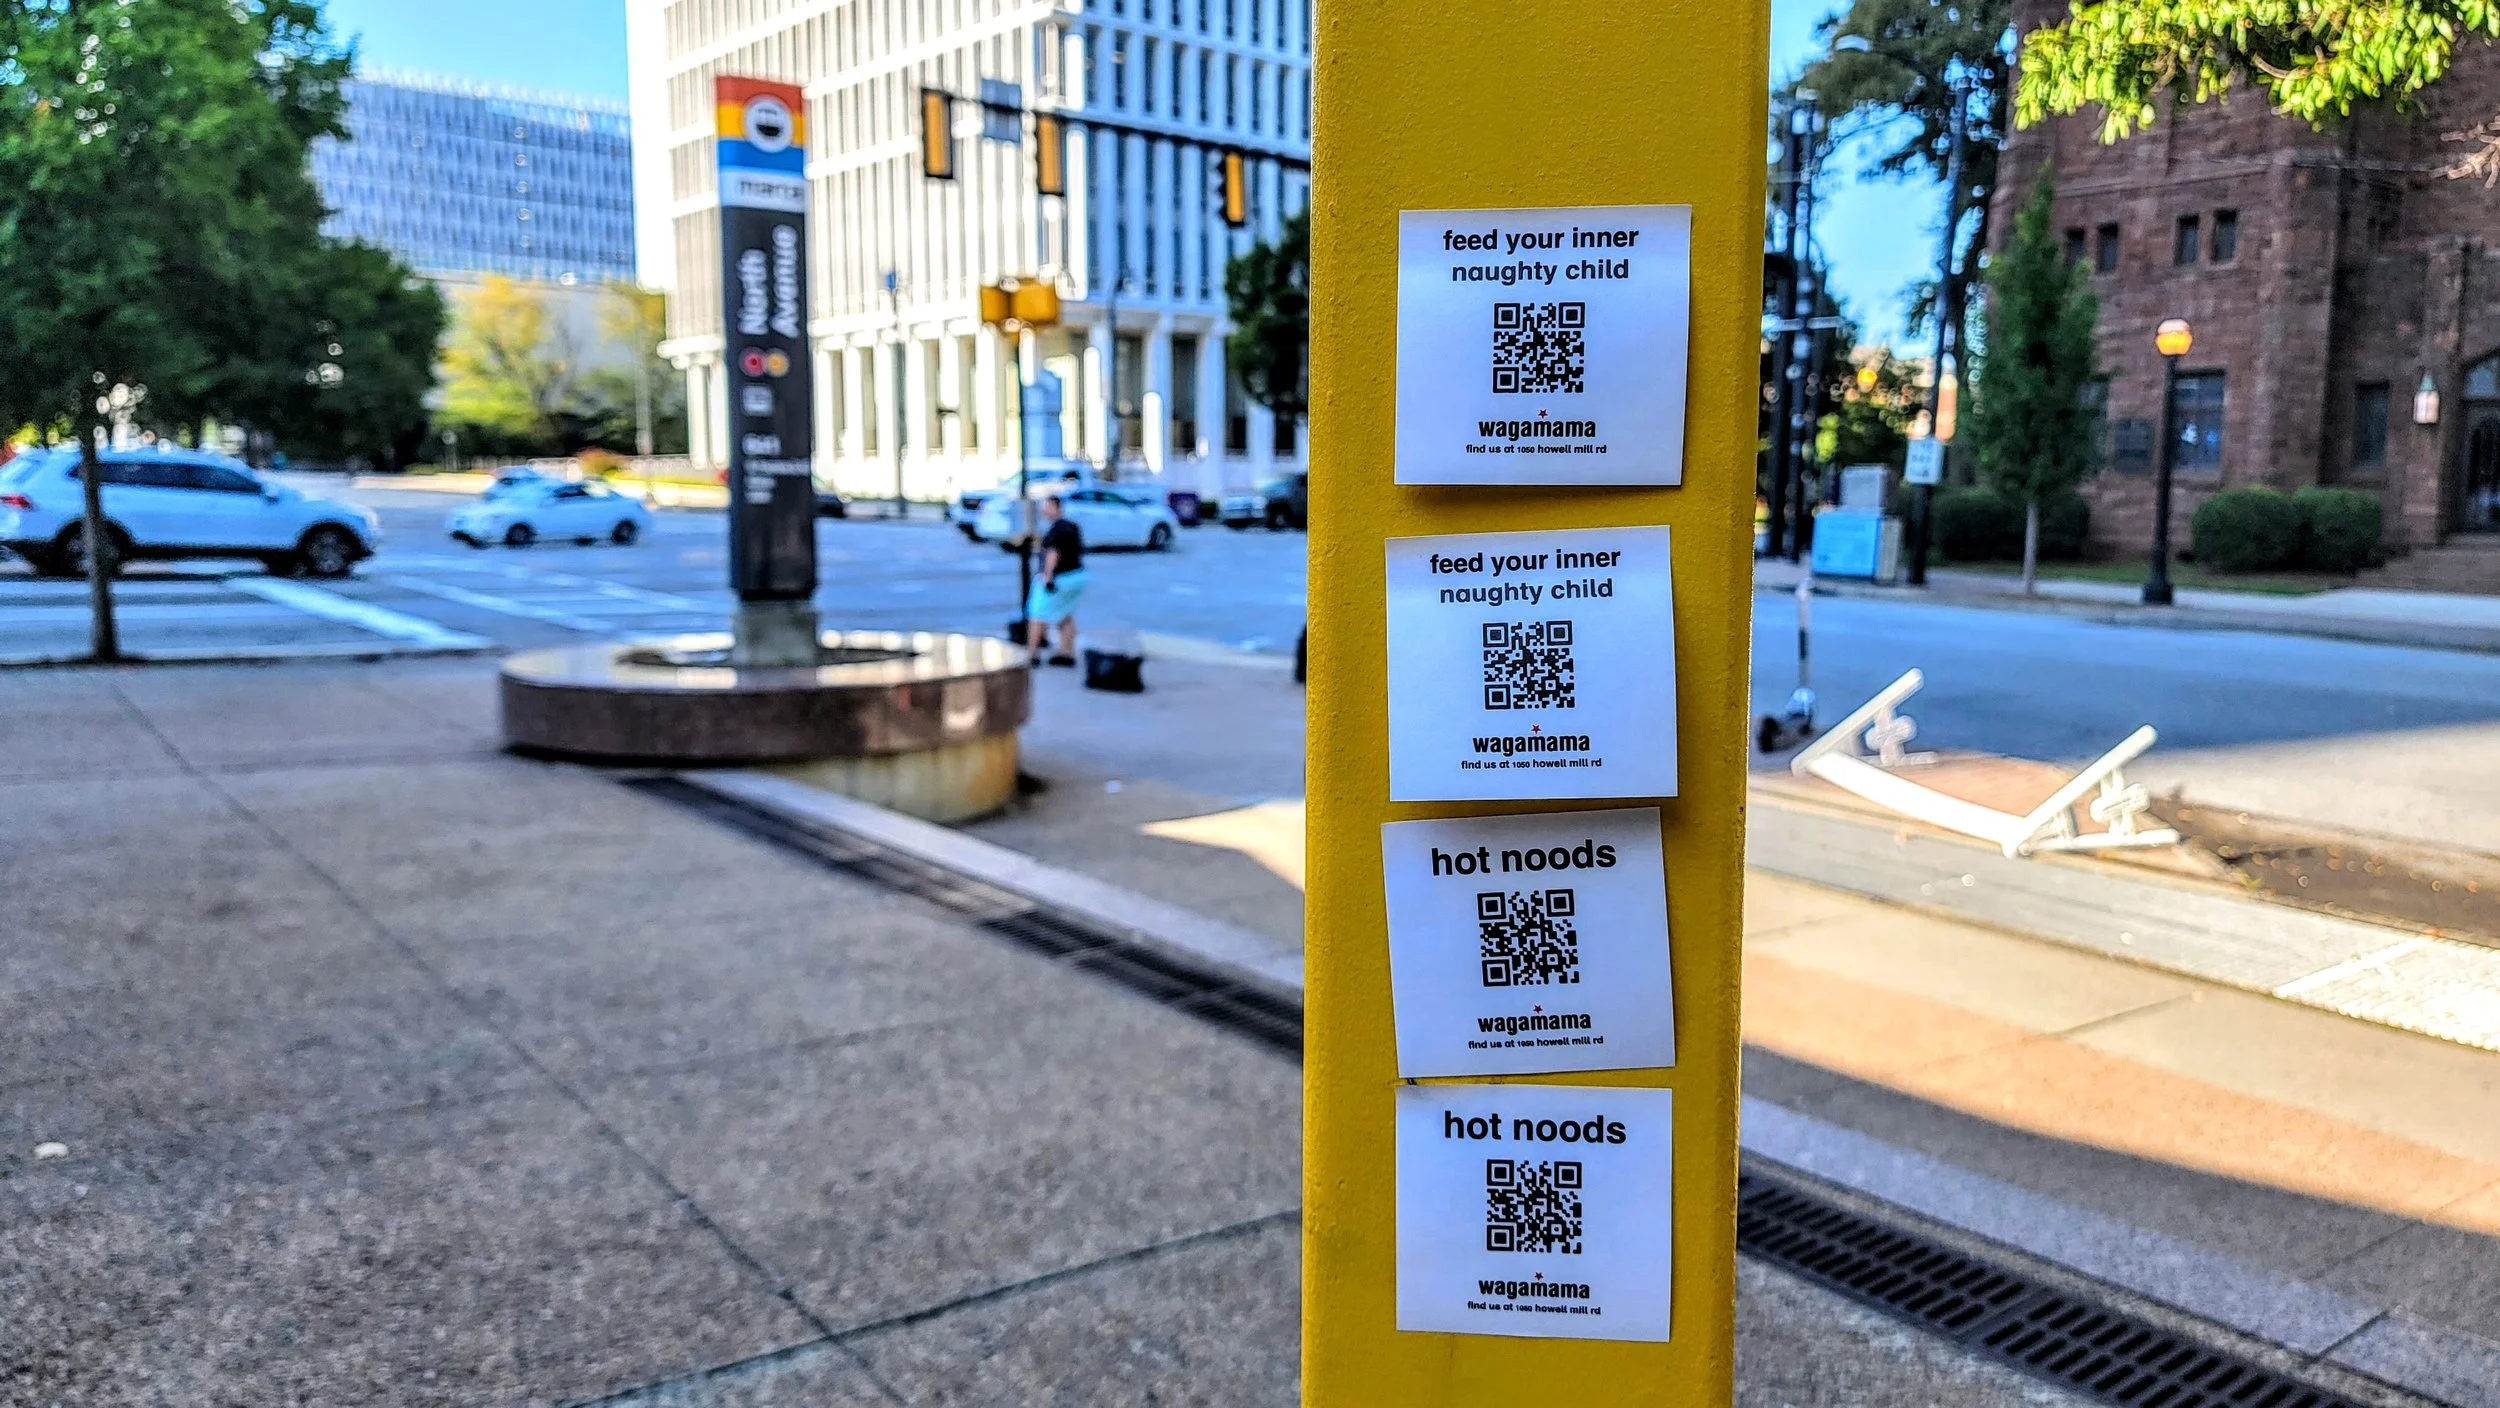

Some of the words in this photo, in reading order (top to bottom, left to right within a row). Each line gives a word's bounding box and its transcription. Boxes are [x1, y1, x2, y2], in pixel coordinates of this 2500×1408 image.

[1443, 229, 1498, 250] feed
[1506, 230, 1565, 255] your
[1572, 227, 1639, 248] inner
[1452, 261, 1558, 285] naughty
[1565, 259, 1629, 279] child
[1479, 420, 1596, 441] wagamama
[1466, 444, 1486, 454] find
[1489, 446, 1501, 454] us
[1504, 445, 1514, 454] at
[1517, 446, 1535, 454] 1050
[1538, 444, 1571, 454] howell
[1574, 444, 1593, 454] mill
[1596, 444, 1607, 454] rd
[1430, 552, 1483, 574] feed
[1491, 554, 1548, 577] your
[1556, 549, 1621, 569] inner
[1440, 582, 1543, 606] naughty
[1551, 578, 1613, 599] child
[1473, 735, 1590, 757] wagamama
[1461, 760, 1481, 769] find
[1484, 761, 1496, 769] us
[1499, 760, 1509, 769] at
[1512, 761, 1530, 769] 1050
[1533, 759, 1566, 768] howell
[1569, 758, 1588, 767] mill
[1591, 758, 1602, 767] rd
[1431, 846, 1491, 876] hot
[1502, 839, 1617, 873] noods
[1478, 1013, 1591, 1036] wagamama
[1468, 1040, 1488, 1049] find
[1490, 1041, 1502, 1049] us
[1505, 1040, 1515, 1048] at
[1537, 1037, 1570, 1047] howell
[1572, 1036, 1591, 1045] mill
[1593, 1035, 1604, 1044] rd
[1444, 1110, 1502, 1140] hot
[1513, 1115, 1627, 1144] noods
[1478, 1279, 1590, 1299] wagamama
[1467, 1301, 1486, 1310] find
[1503, 1303, 1513, 1311] at
[1569, 1306, 1588, 1315] mill
[1590, 1306, 1601, 1315] rd
